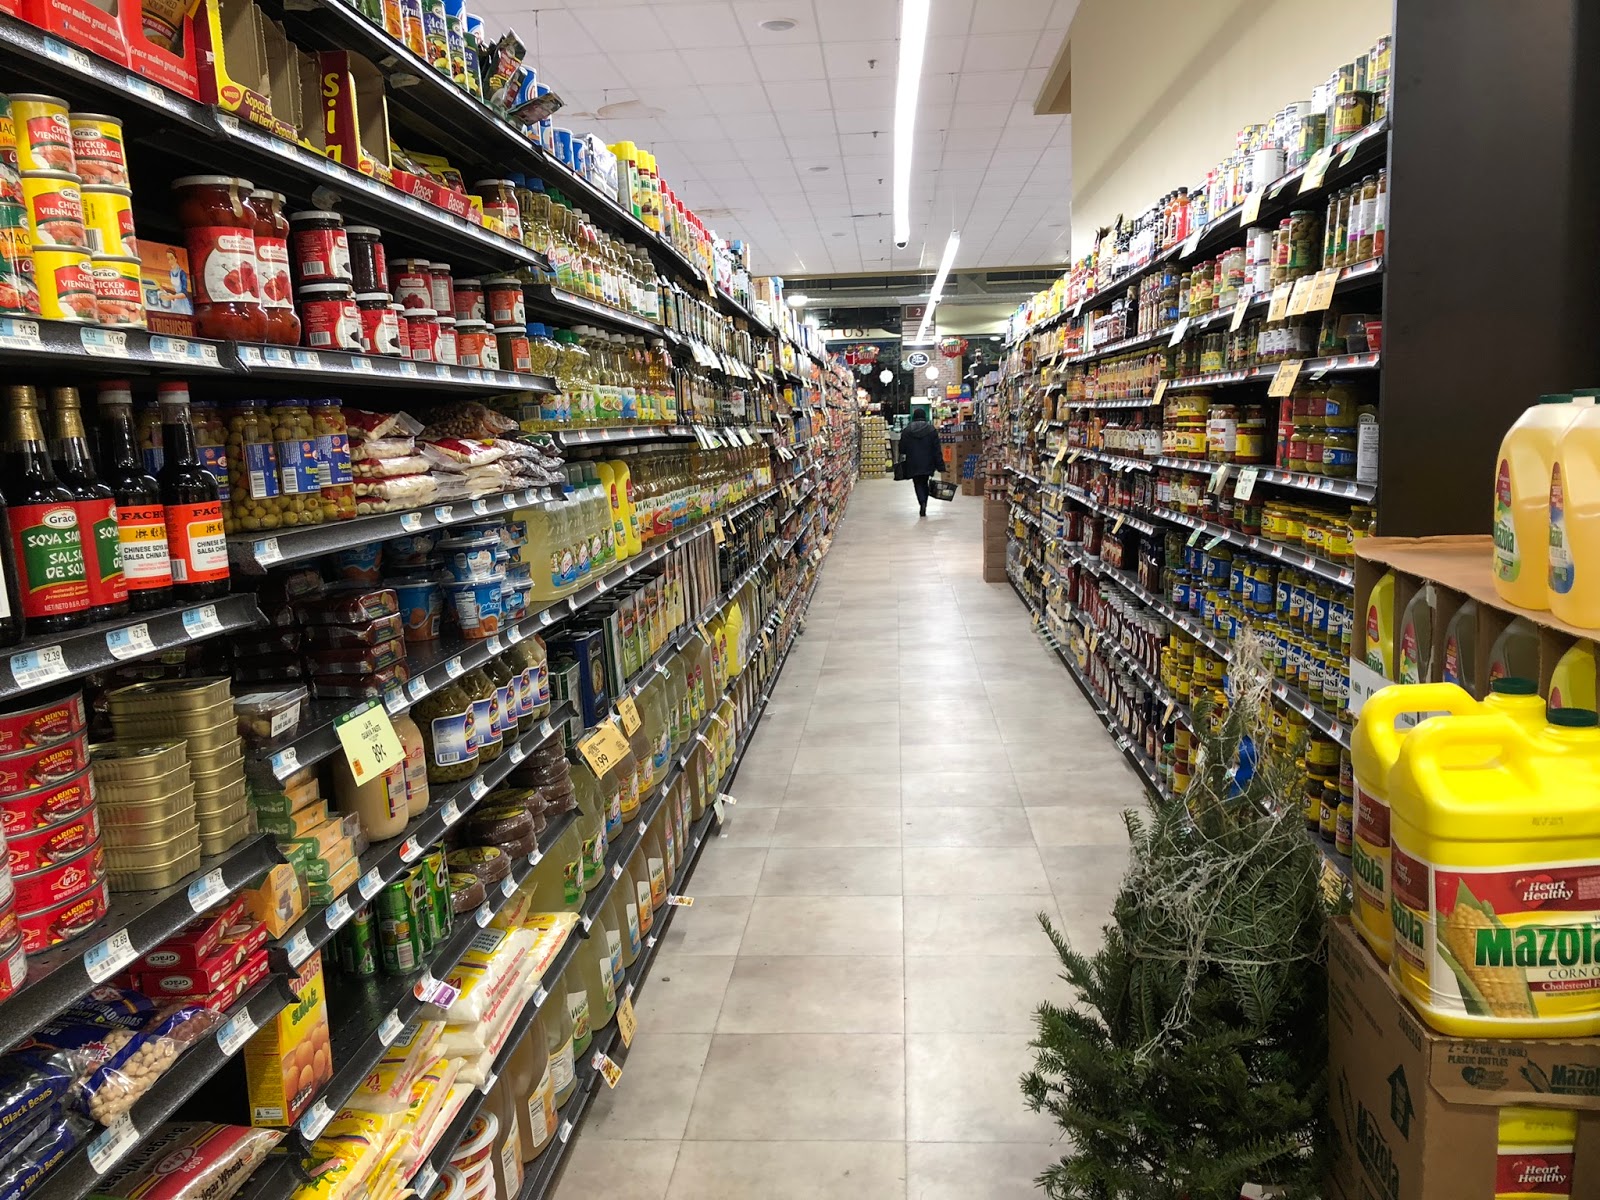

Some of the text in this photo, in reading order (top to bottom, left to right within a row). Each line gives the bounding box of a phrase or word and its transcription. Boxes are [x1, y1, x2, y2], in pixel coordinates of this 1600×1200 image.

[72, 8, 91, 24] makes
[91, 18, 107, 32] great
[130, 45, 147, 58] Grace
[147, 54, 164, 67] makes
[164, 62, 177, 72] great
[244, 91, 265, 110] Sopas
[33, 130, 65, 142] VIENNA
[73, 129, 98, 137] Grace
[86, 148, 121, 159] SAUSAGES
[412, 179, 434, 201] Bases
[447, 193, 465, 215] Bases
[39, 207, 73, 218] VIENNA
[92, 270, 117, 278] Grace
[61, 280, 90, 290] VIENNA
[104, 288, 139, 297] SAUSAGES
[916, 308, 921, 316] 2
[19, 324, 37, 336] $1.39
[108, 334, 124, 345] $1.19
[49, 514, 76, 524] Grace
[27, 532, 62, 548] SOYA
[197, 539, 219, 548] CHINESE
[124, 546, 151, 554] CHINESE
[197, 546, 215, 554] SALSA
[124, 553, 144, 561] SALSA
[46, 567, 65, 579] DE
[133, 627, 147, 638] $2.79
[43, 651, 60, 663] $2.39
[34, 710, 69, 727] SARDINES
[361, 724, 382, 740] GUAVA PASTE
[39, 748, 74, 767] SARDINES
[371, 743, 387, 763] 89¢
[47, 786, 80, 806] SARDINES
[50, 824, 85, 845] SARDINES
[1529, 880, 1566, 892] Heart
[1523, 890, 1573, 901] Healthy
[61, 898, 94, 921] SARDINES
[112, 935, 128, 948] $2.69
[150, 954, 176, 962] Grace
[1548, 968, 1587, 979] CORN
[1542, 981, 1592, 991] Cholesterol
[1449, 1043, 1454, 1053] 2
[1448, 1055, 1508, 1067] PLASTIC BOTTLES
[3, 1088, 53, 1125] Black Beans
[25, 1150, 65, 1187] Black Beans
[218, 1158, 244, 1184] Wheat
[1525, 1164, 1560, 1175] Heart
[1518, 1173, 1566, 1183] Healthy
